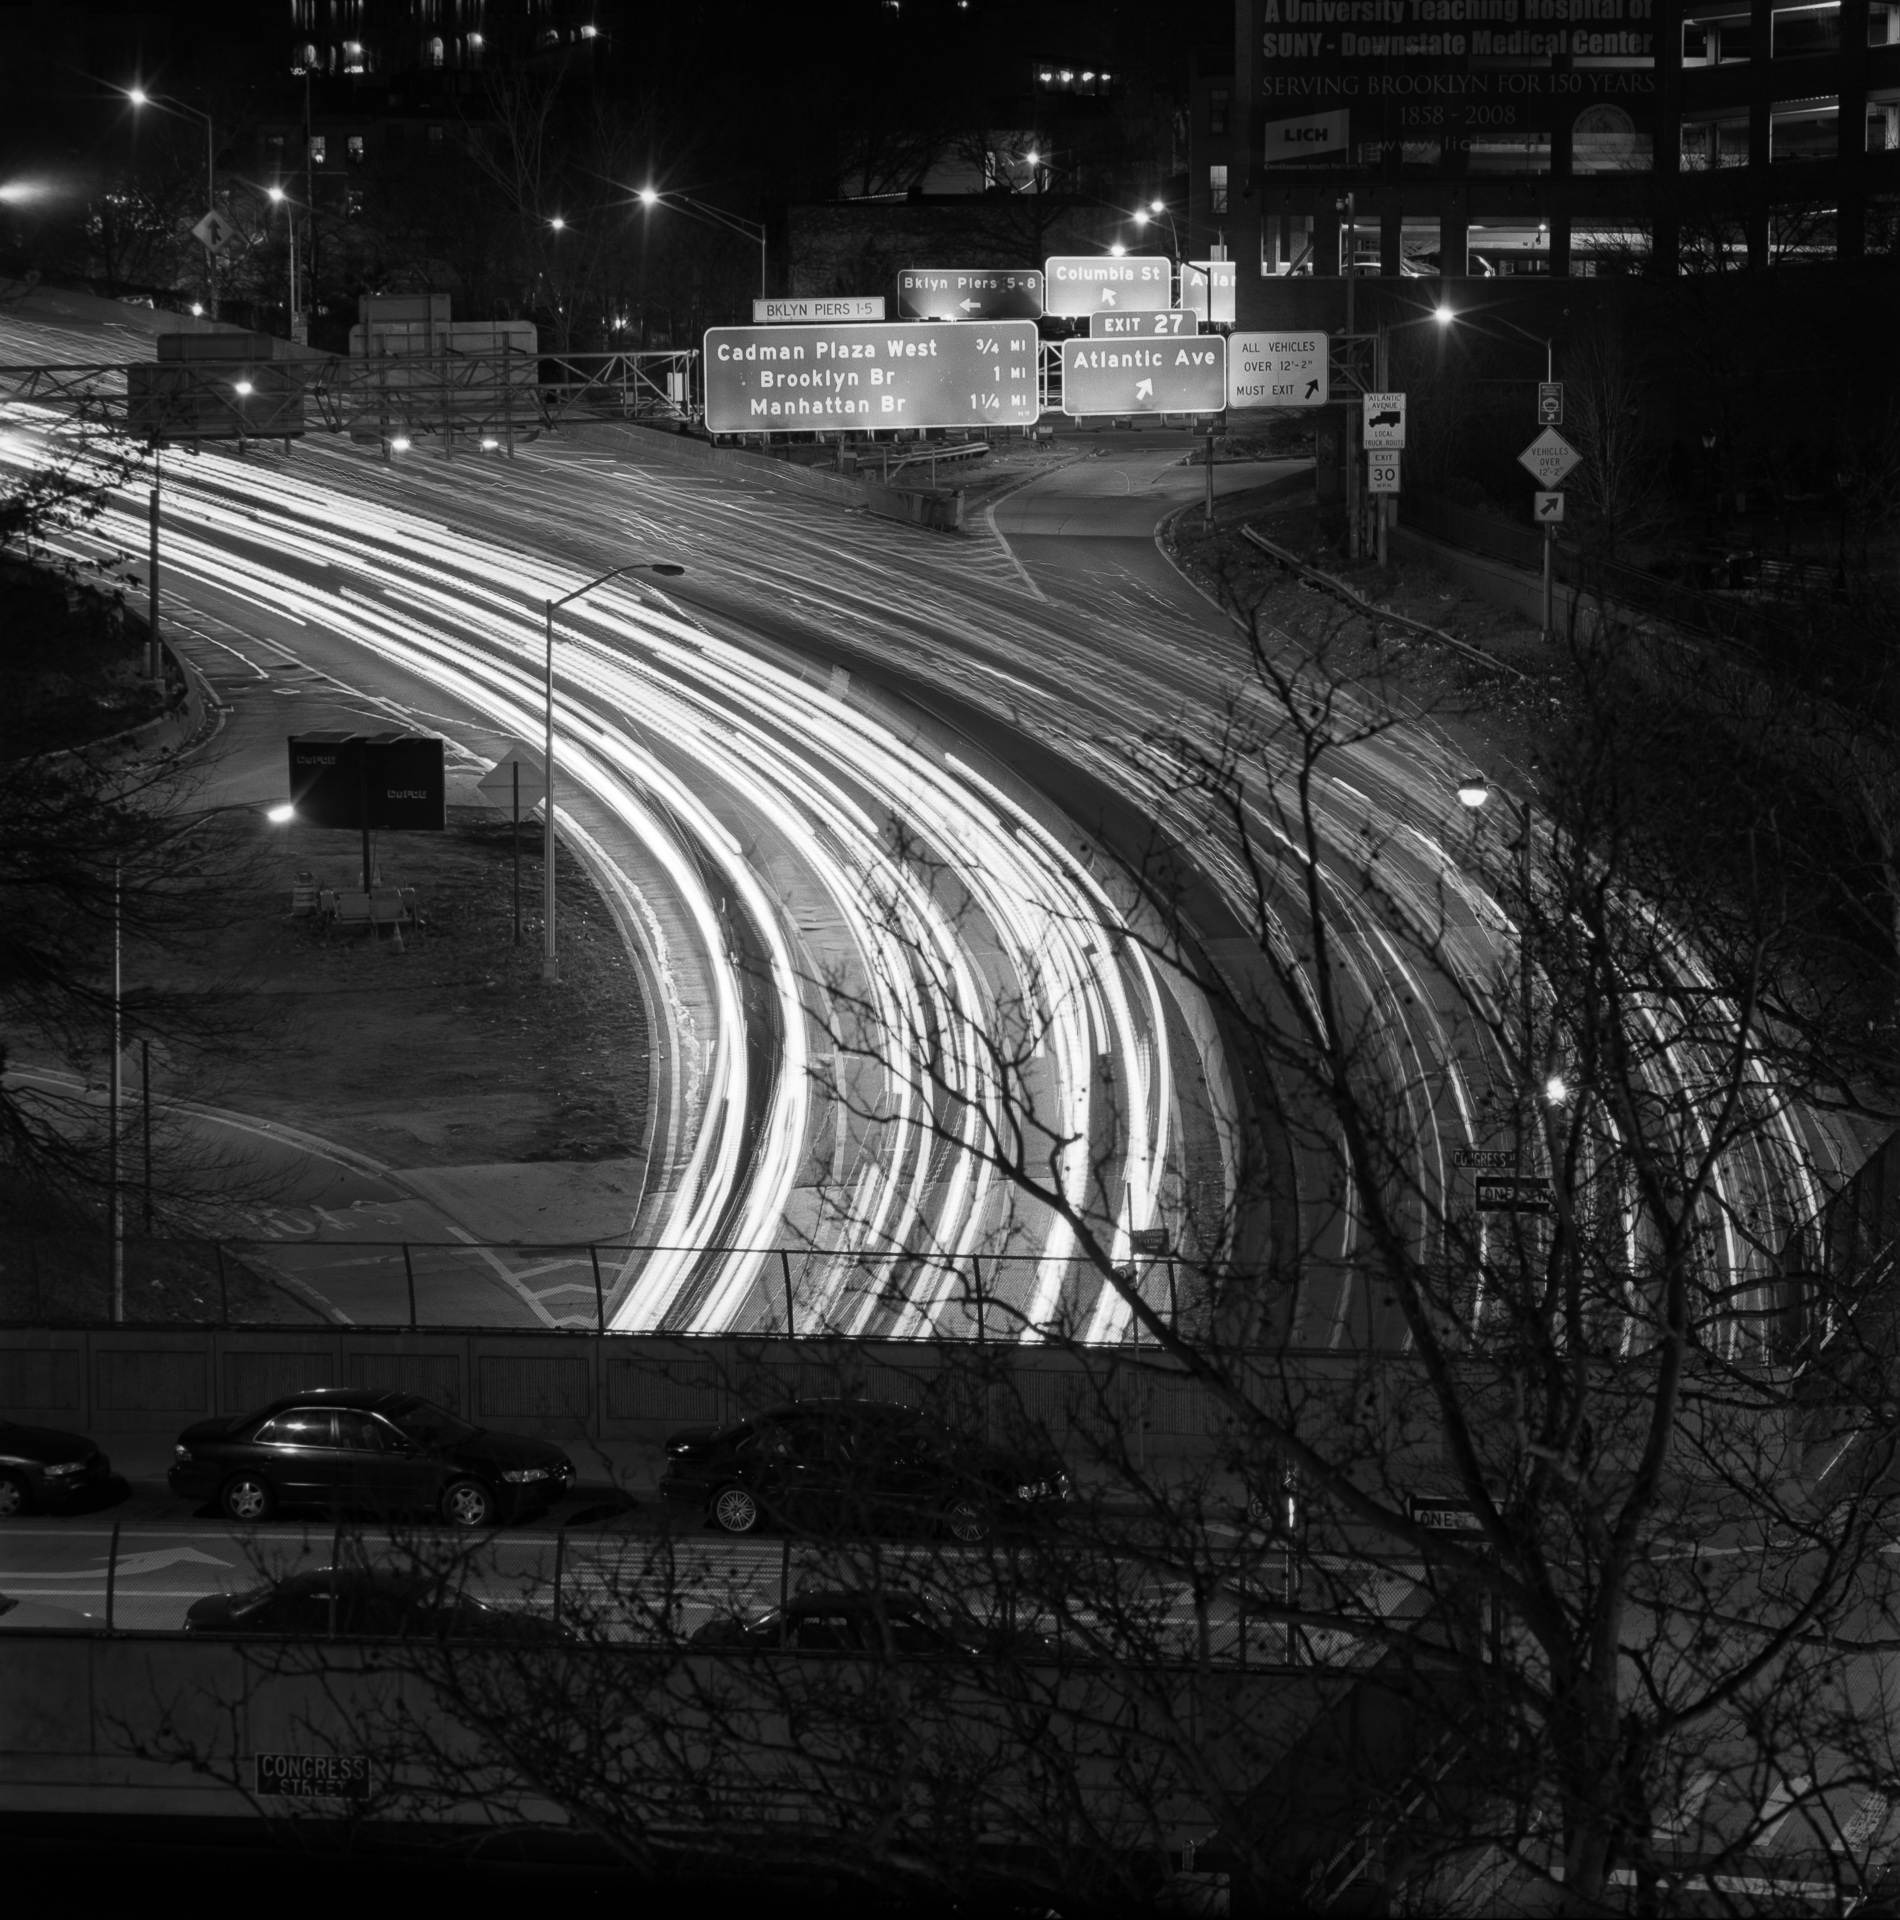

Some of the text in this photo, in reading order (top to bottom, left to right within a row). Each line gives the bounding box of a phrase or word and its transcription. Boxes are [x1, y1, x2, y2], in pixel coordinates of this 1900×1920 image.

[1264, 0, 1652, 24] A University Teaching Hospital of
[1263, 32, 1323, 58] SUNY
[1341, 32, 1466, 57] Downstate
[1471, 30, 1567, 55] Medical
[1572, 29, 1654, 55] Center
[1262, 73, 1655, 96] SERVING BROOKLYN FOR 150 YEARS
[1400, 106, 1444, 126] 1858
[1465, 105, 1516, 125] 2008
[1284, 128, 1328, 142] LICH
[1055, 265, 1160, 281] Columbia St
[1190, 271, 1236, 287] Ala
[904, 276, 1037, 292] Bklyn Piers 5-8
[766, 302, 873, 317] BKLYN PIERS 1-5
[1104, 314, 1183, 334] EXIT 27
[717, 343, 806, 362] Cadman
[816, 341, 876, 360] Plaza
[887, 338, 938, 358] West
[1010, 339, 1027, 352] MI
[1241, 341, 1316, 354] ALL VEHICLES
[1073, 349, 1216, 369] Atlantic Ave
[1244, 361, 1272, 373] OVER
[760, 365, 1027, 393] Brooklyn Br 1 MI
[1236, 384, 1295, 397] MUST EXIT
[750, 395, 870, 417] Manhattan
[881, 394, 906, 413] Br
[1011, 394, 1027, 407] MI
[1374, 430, 1394, 438] LOCAL
[1365, 439, 1404, 447] TRUCK ROUTE
[1531, 447, 1569, 456] VEHICLES
[1540, 457, 1561, 466] OVER
[1373, 468, 1396, 482] 30
[1420, 1511, 1453, 1527] ONE
[261, 1755, 365, 1780] CONGRESS
[280, 1778, 346, 1798] STREET
